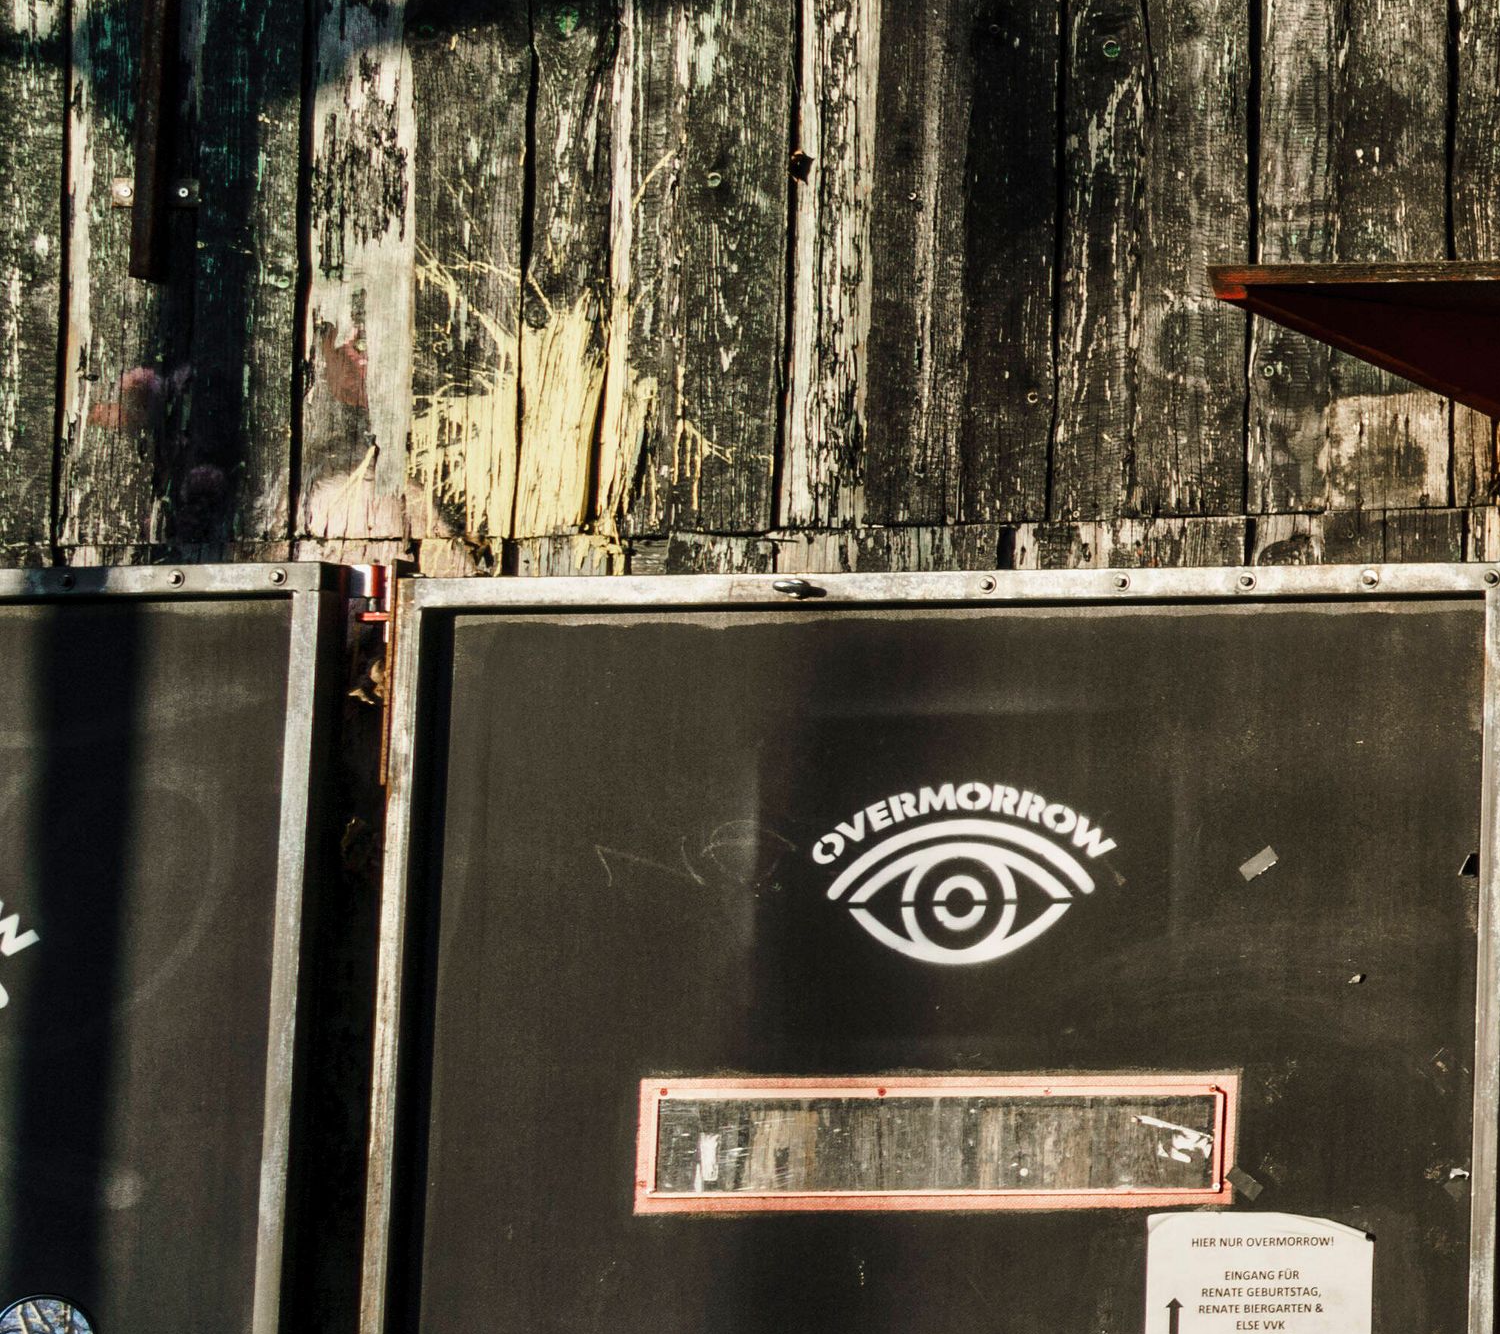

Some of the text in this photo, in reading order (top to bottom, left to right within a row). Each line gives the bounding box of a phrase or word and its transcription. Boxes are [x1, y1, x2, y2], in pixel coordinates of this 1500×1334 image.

[811, 781, 1118, 868] OVERMORROW
[1191, 1236, 1334, 1248] HIER NUR OVERMORROW!
[1224, 1268, 1300, 1281] EINGANG FÜR
[1201, 1286, 1322, 1299] RENATE GEBURTSTAG,
[1198, 1303, 1324, 1314] RENATE BIERGARTEN &
[1236, 1320, 1286, 1330] ELSE VVK
